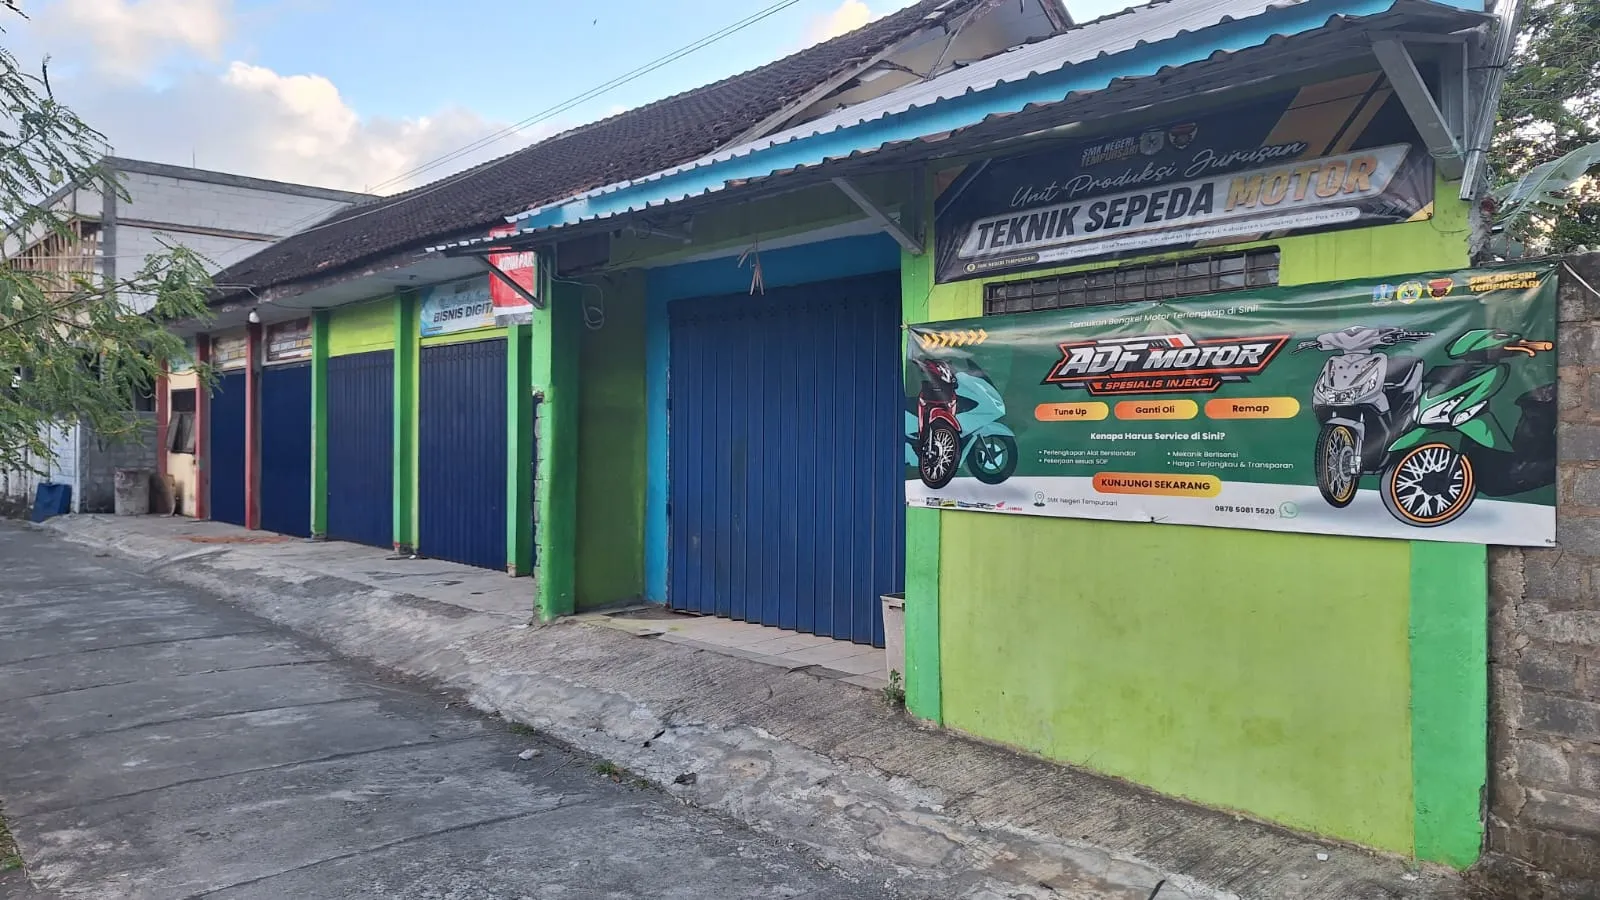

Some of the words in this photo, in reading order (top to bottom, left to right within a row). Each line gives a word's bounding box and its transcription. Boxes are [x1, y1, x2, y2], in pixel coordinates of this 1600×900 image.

[1010, 182, 1058, 207] Unit
[1065, 161, 1178, 198] Produksi
[1184, 142, 1307, 178] Jurusan
[978, 205, 1082, 251] TEKNIK
[1084, 182, 1215, 233] SEPEDA
[1224, 155, 1378, 213] MOTOR
[433, 307, 464, 323] BISNIS
[1069, 320, 1107, 329] Temukan
[1108, 315, 1143, 326] Bengkel
[1144, 313, 1170, 323] Motor
[1172, 308, 1224, 321] Terlengkap
[1227, 307, 1236, 315] di
[1058, 343, 1150, 376] ADF
[1143, 343, 1273, 371] MOTOR
[1105, 379, 1163, 390] SPESIALIS
[1166, 377, 1213, 389] INJEKSI
[1054, 408, 1073, 417] Tune
[1074, 408, 1087, 418] Up
[1135, 406, 1161, 415] Ganti
[1162, 405, 1175, 415] Oli
[1232, 403, 1269, 414] Remap
[1090, 432, 1123, 442] Kenapa
[1124, 432, 1152, 440] Harus
[1154, 432, 1190, 440] Service
[1191, 431, 1201, 440] di
[1202, 431, 1226, 441] Sini?
[1172, 460, 1194, 469] Harga
[1196, 461, 1238, 470] Terjangkau
[1248, 461, 1294, 470] Transparan
[1101, 478, 1153, 489] KUNJUNGI
[1154, 479, 1210, 491] SEKARANG
[1083, 499, 1118, 507] Tempursari
[1214, 505, 1233, 513] 0878
